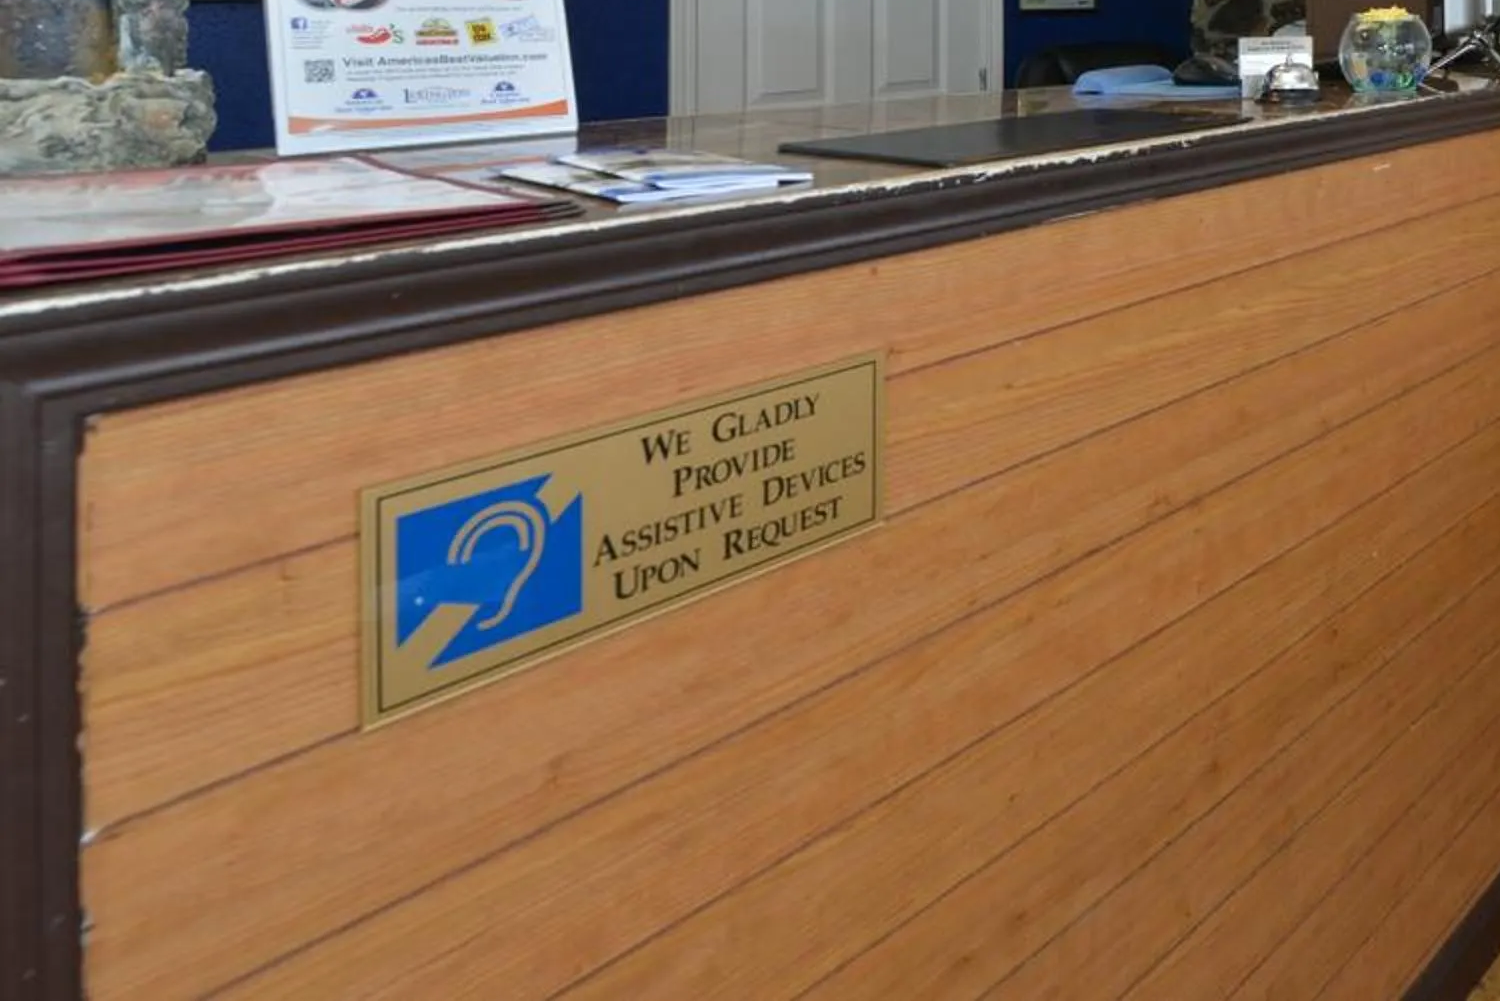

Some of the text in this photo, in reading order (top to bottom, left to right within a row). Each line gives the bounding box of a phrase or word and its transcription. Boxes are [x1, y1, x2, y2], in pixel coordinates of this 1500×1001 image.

[342, 57, 373, 67] Visit
[640, 392, 821, 465] WE GLADLY
[672, 438, 797, 498] PROVIDE
[593, 452, 867, 567] ASSISTIVE DEVICES
[612, 496, 844, 600] UPON REQUEST
